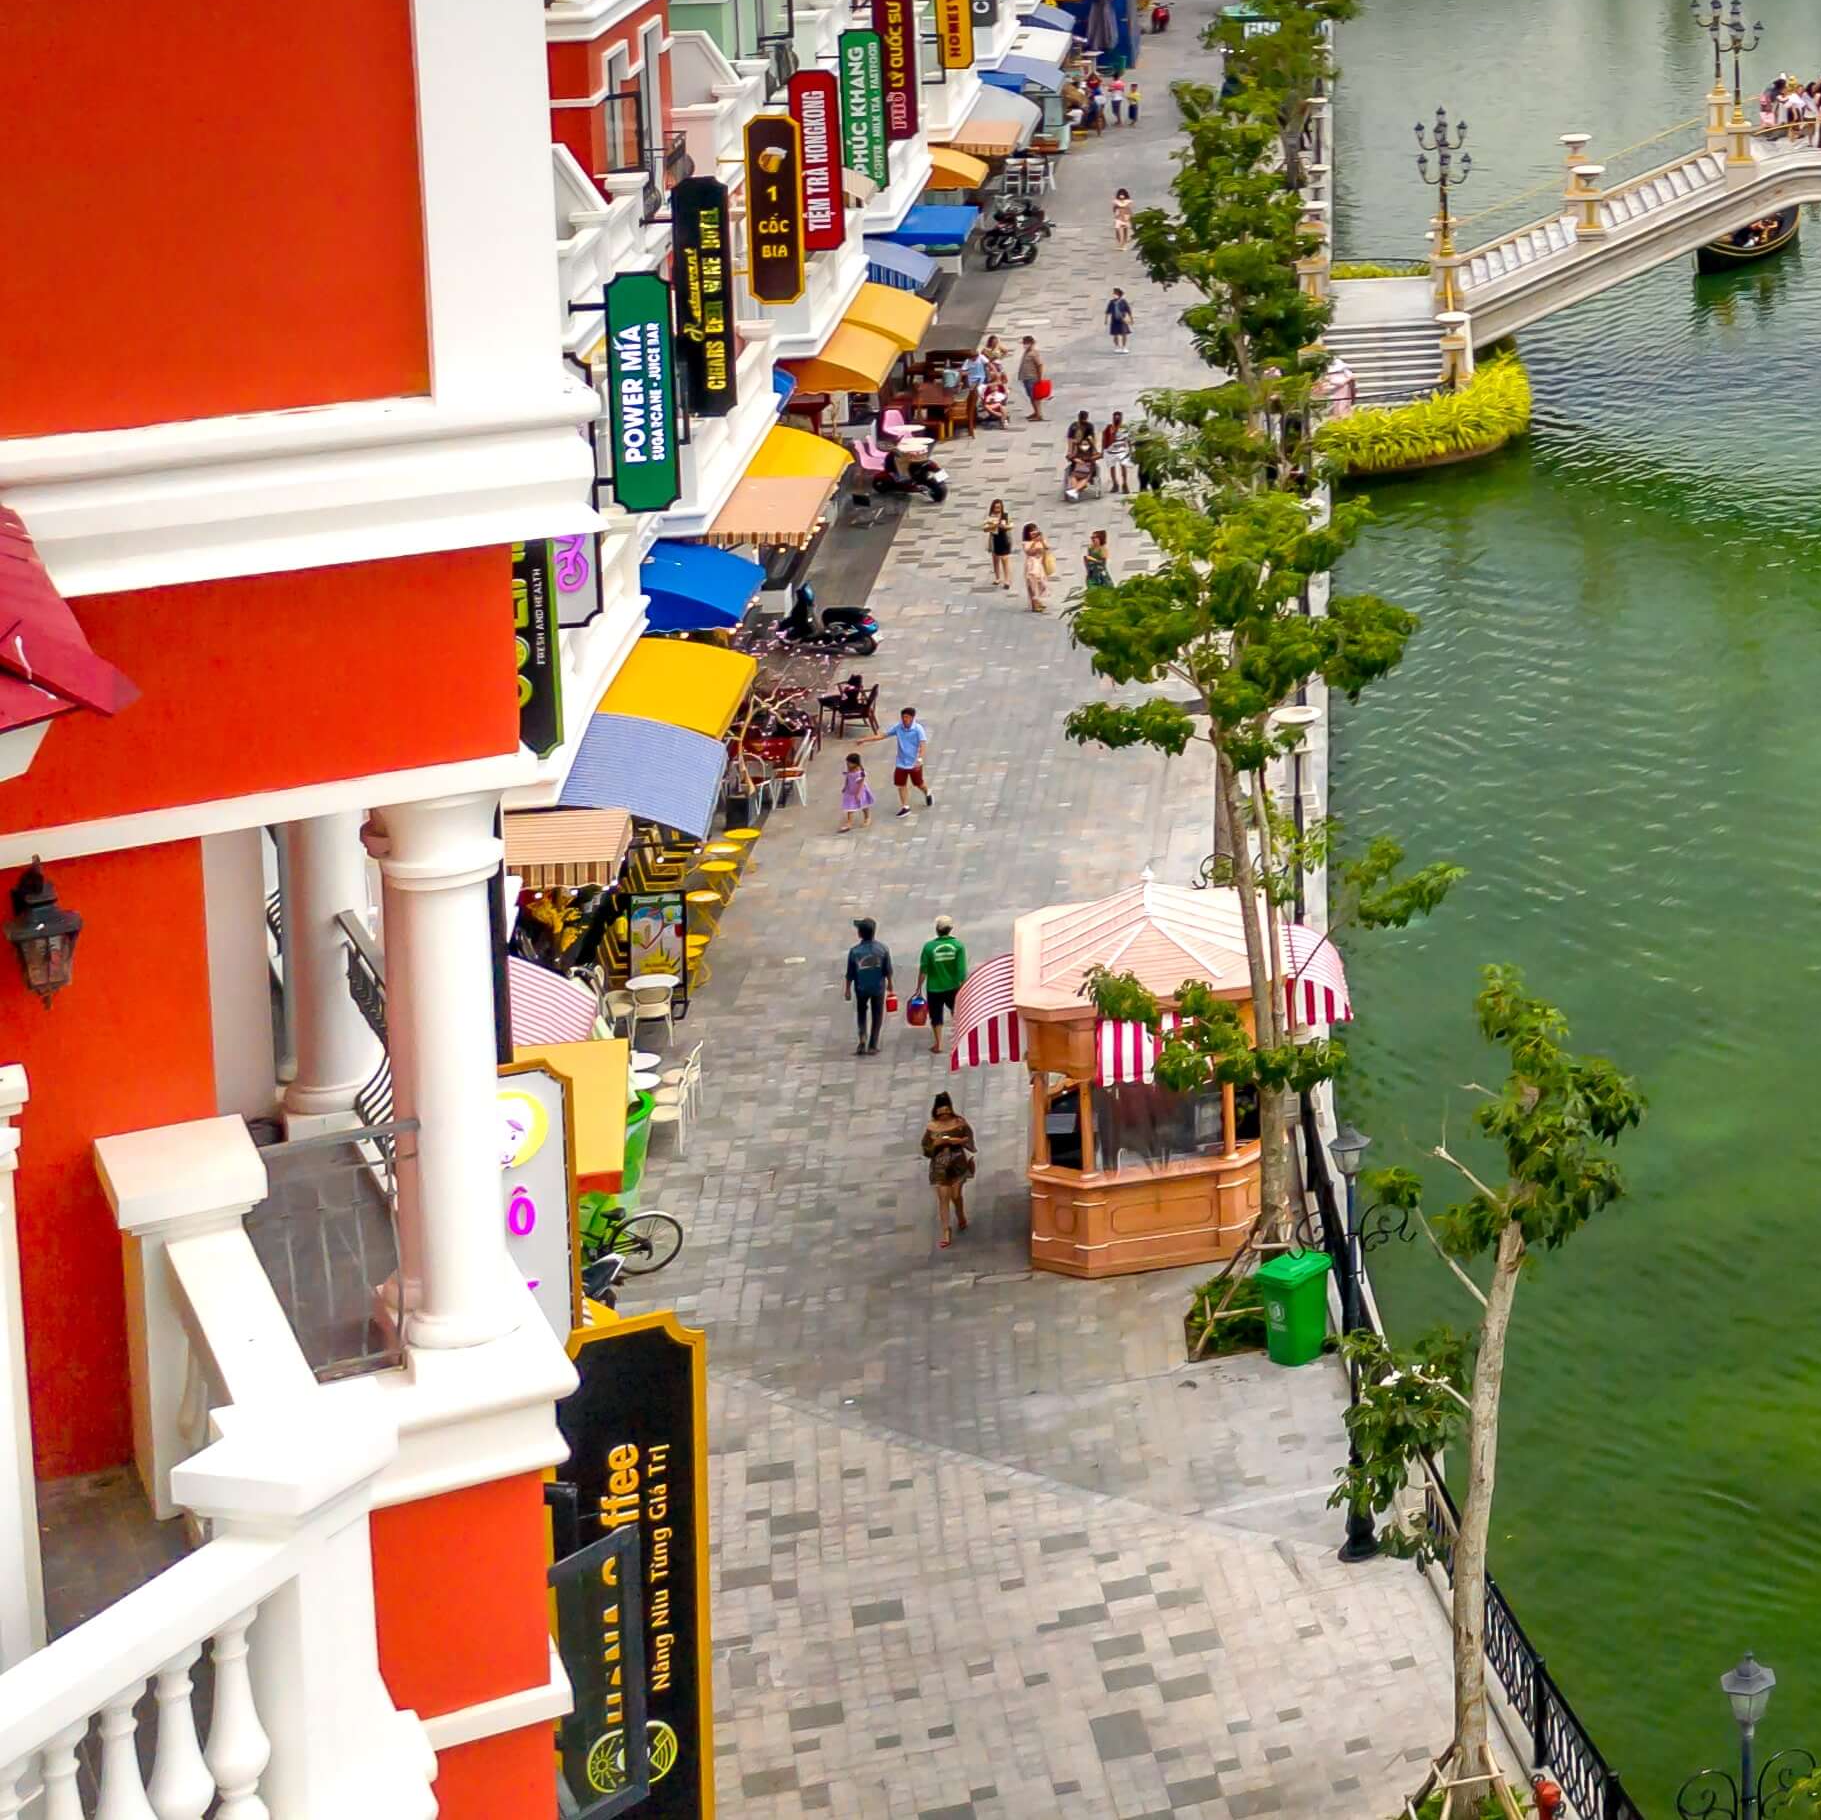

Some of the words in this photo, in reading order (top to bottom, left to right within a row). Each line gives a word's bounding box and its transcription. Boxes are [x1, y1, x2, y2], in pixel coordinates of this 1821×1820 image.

[847, 46, 868, 117] KHANG
[868, 41, 881, 90] FASTFOOD
[871, 95, 882, 112] TEA
[802, 90, 829, 164] HONGKONG
[871, 114, 883, 137] MILK
[846, 121, 870, 176] PHÚC
[872, 144, 884, 179] COFFEE
[767, 185, 778, 202] 1
[801, 165, 830, 198] TRÀ
[758, 212, 790, 234] CỐC
[802, 200, 836, 232] TIỆM
[762, 244, 788, 259] BIA
[613, 323, 643, 372] MÍA
[646, 322, 661, 347] BAR
[647, 348, 663, 381] JUICE
[621, 378, 648, 464] POWER
[649, 388, 666, 461] SUGARCANE
[532, 568, 544, 606] HEALTH
[534, 607, 546, 630] AND
[536, 632, 547, 665] FRESH
[646, 1443, 671, 1477] Trị
[647, 1482, 668, 1520] Giá
[650, 1589, 671, 1628] Niu
